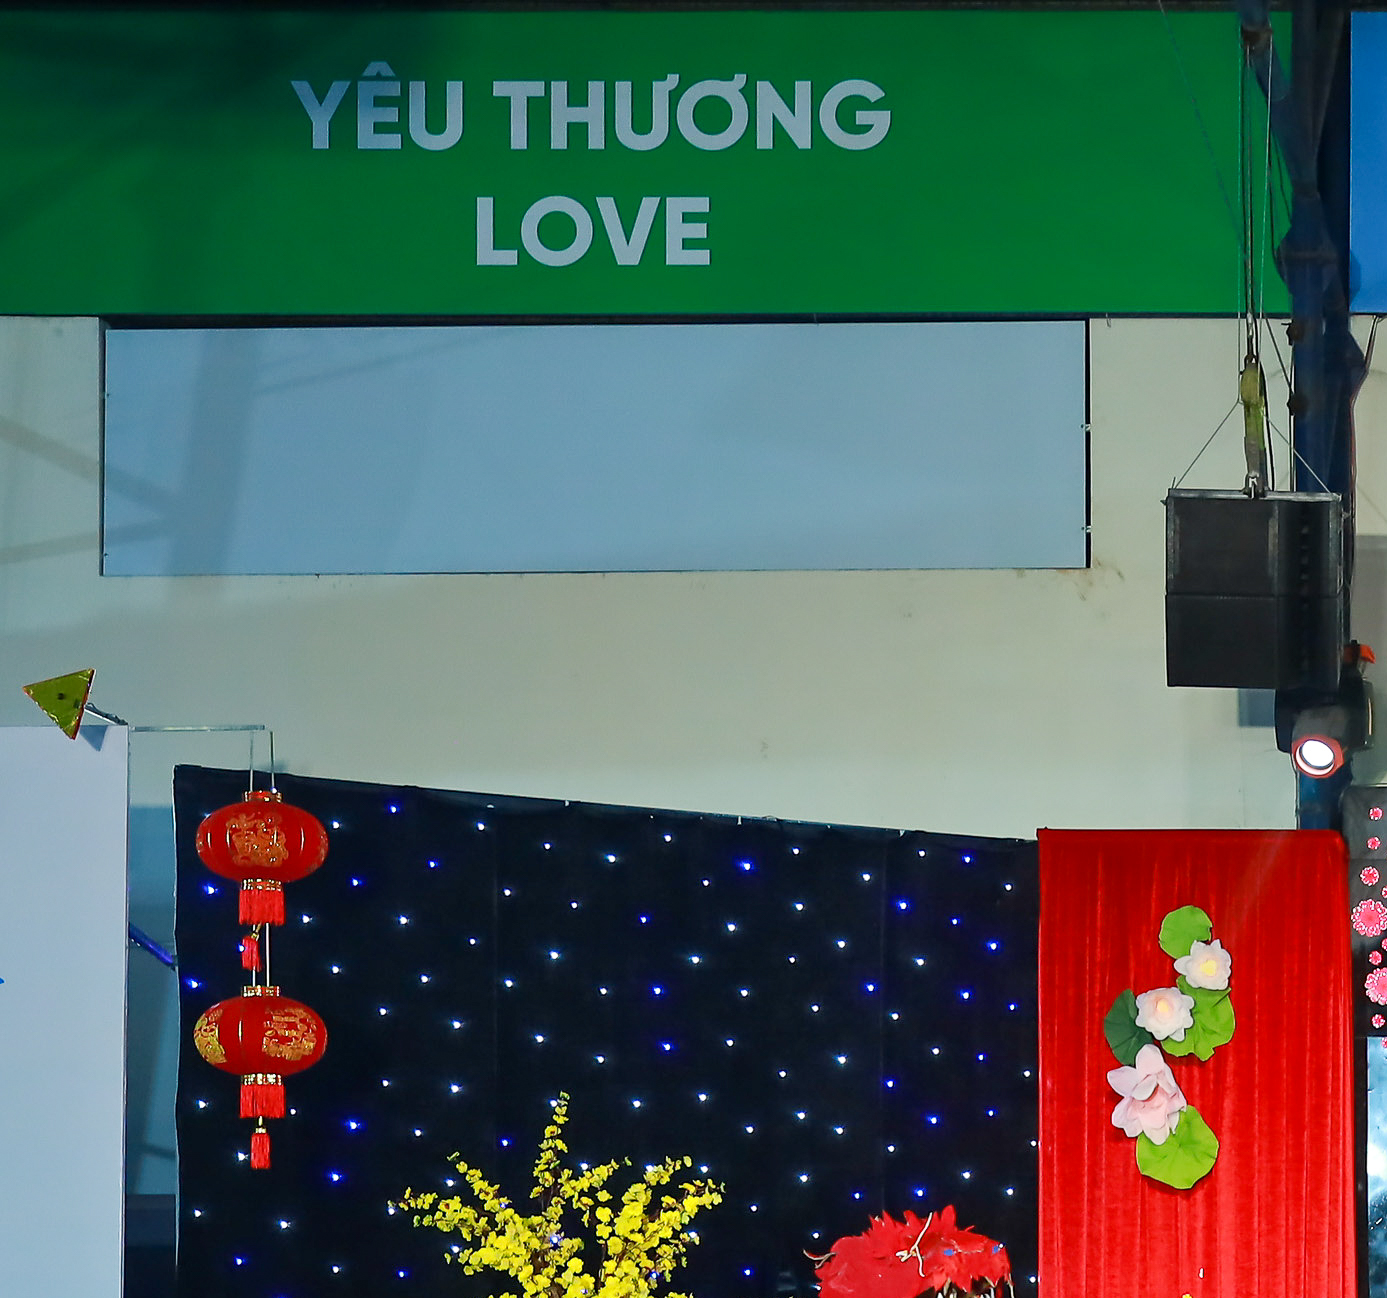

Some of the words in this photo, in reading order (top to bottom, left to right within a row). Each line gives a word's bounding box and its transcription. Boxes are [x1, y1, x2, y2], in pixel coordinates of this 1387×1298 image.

[290, 60, 463, 151] YÊU
[492, 73, 891, 151] THƯƠNG
[476, 195, 711, 266] LOVE
